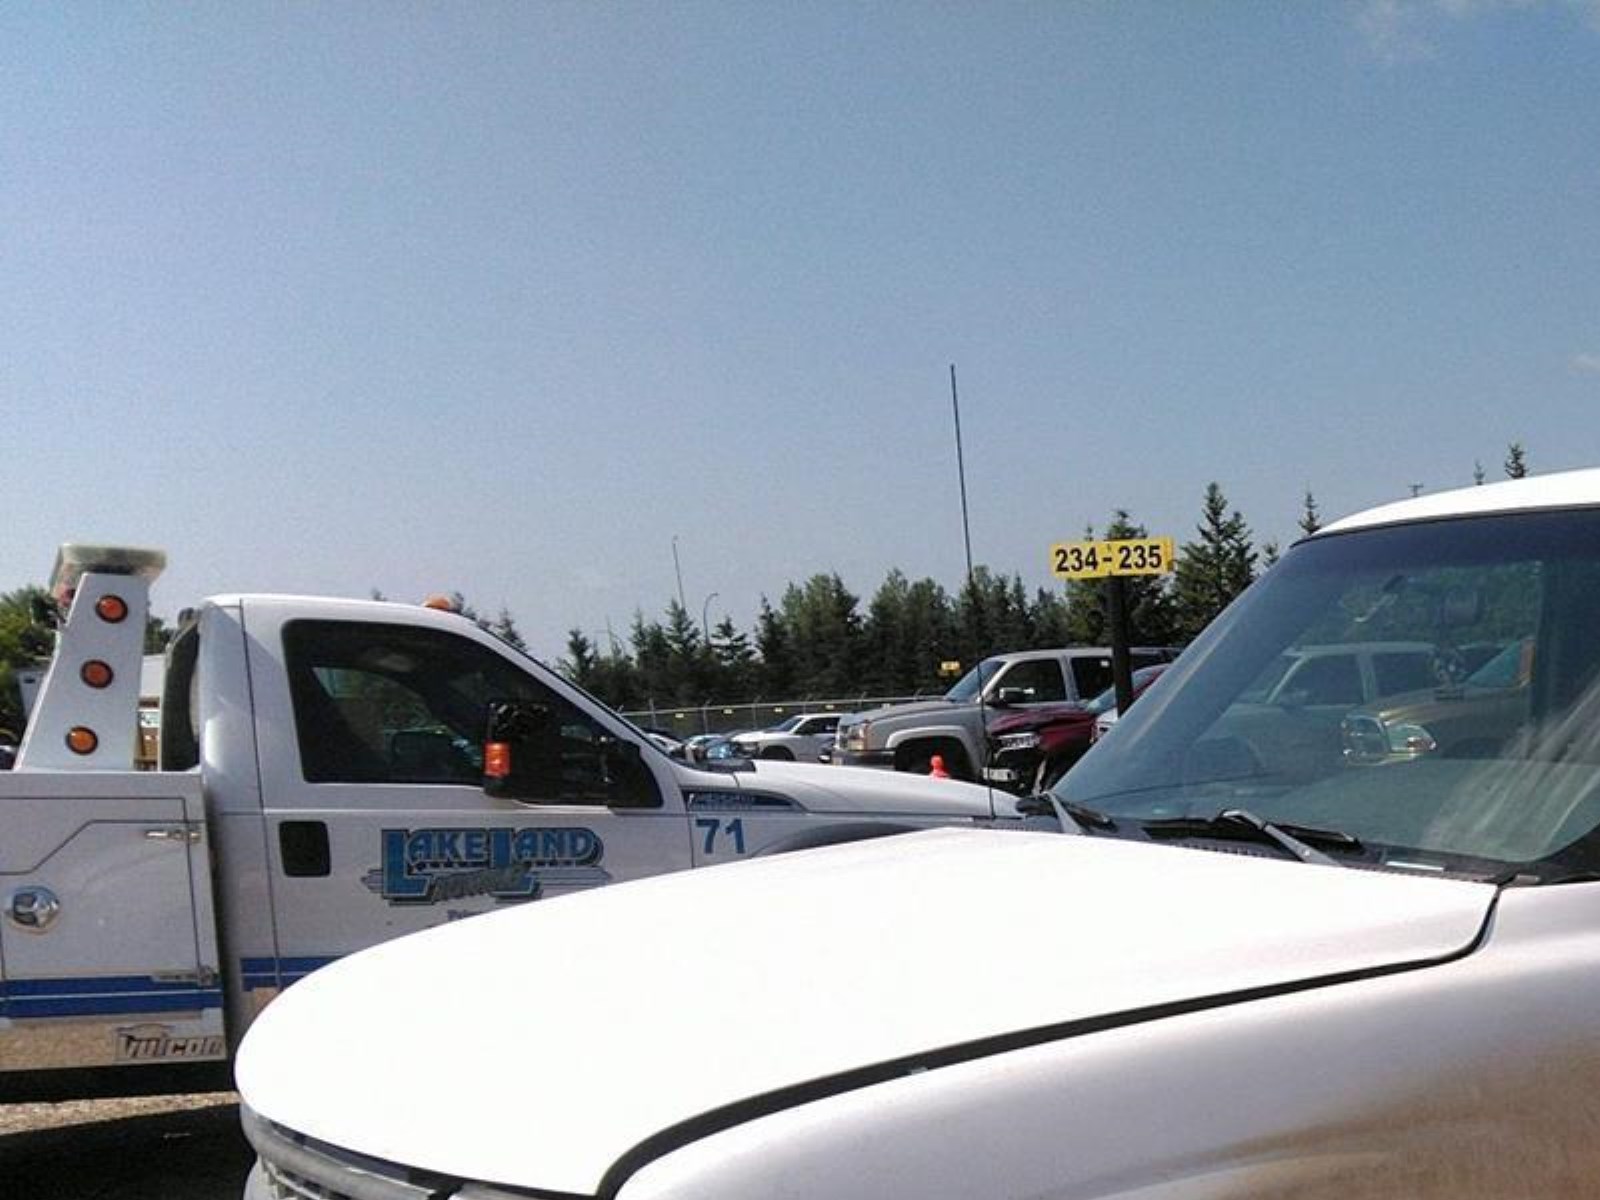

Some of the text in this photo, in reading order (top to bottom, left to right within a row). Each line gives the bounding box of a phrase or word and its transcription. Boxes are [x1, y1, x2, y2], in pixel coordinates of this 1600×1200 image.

[1055, 547, 1098, 572] 234
[1118, 544, 1162, 569] 235
[695, 817, 745, 854] 71
